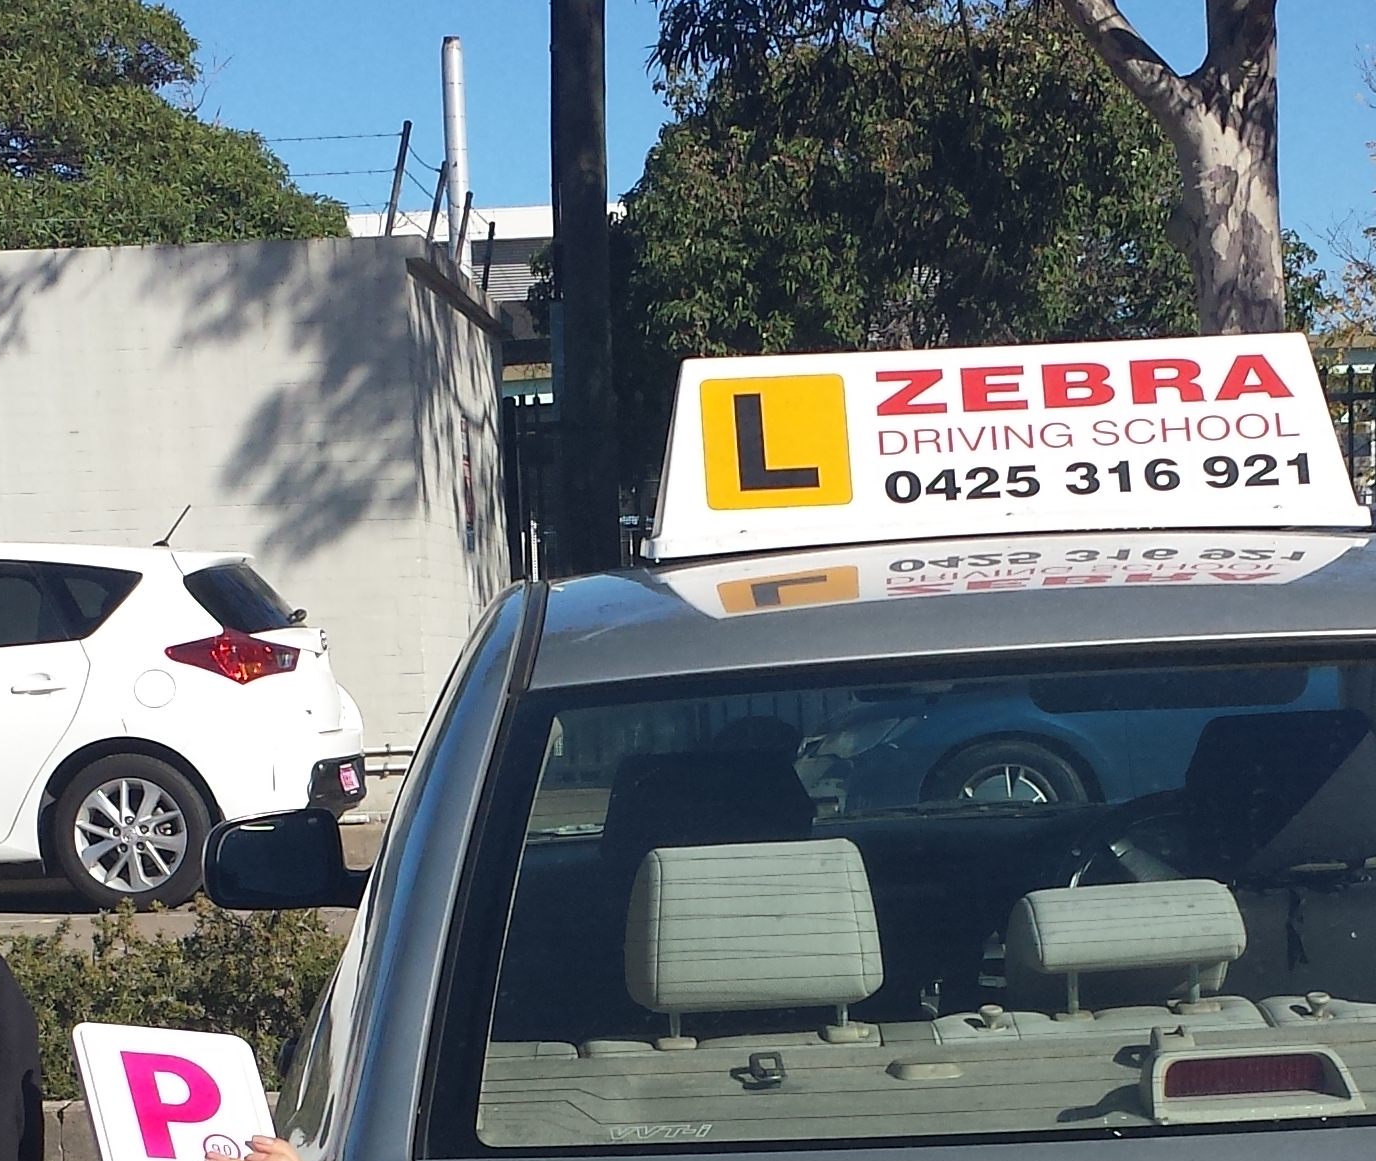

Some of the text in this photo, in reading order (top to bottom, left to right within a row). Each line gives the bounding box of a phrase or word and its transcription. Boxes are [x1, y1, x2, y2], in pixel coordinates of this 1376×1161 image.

[875, 354, 1295, 416] ZEBRA
[733, 394, 820, 491] L
[877, 413, 1301, 456] DRIVING SCHOOL
[884, 452, 1311, 504] 0425 316 921
[120, 1051, 221, 1159] P
